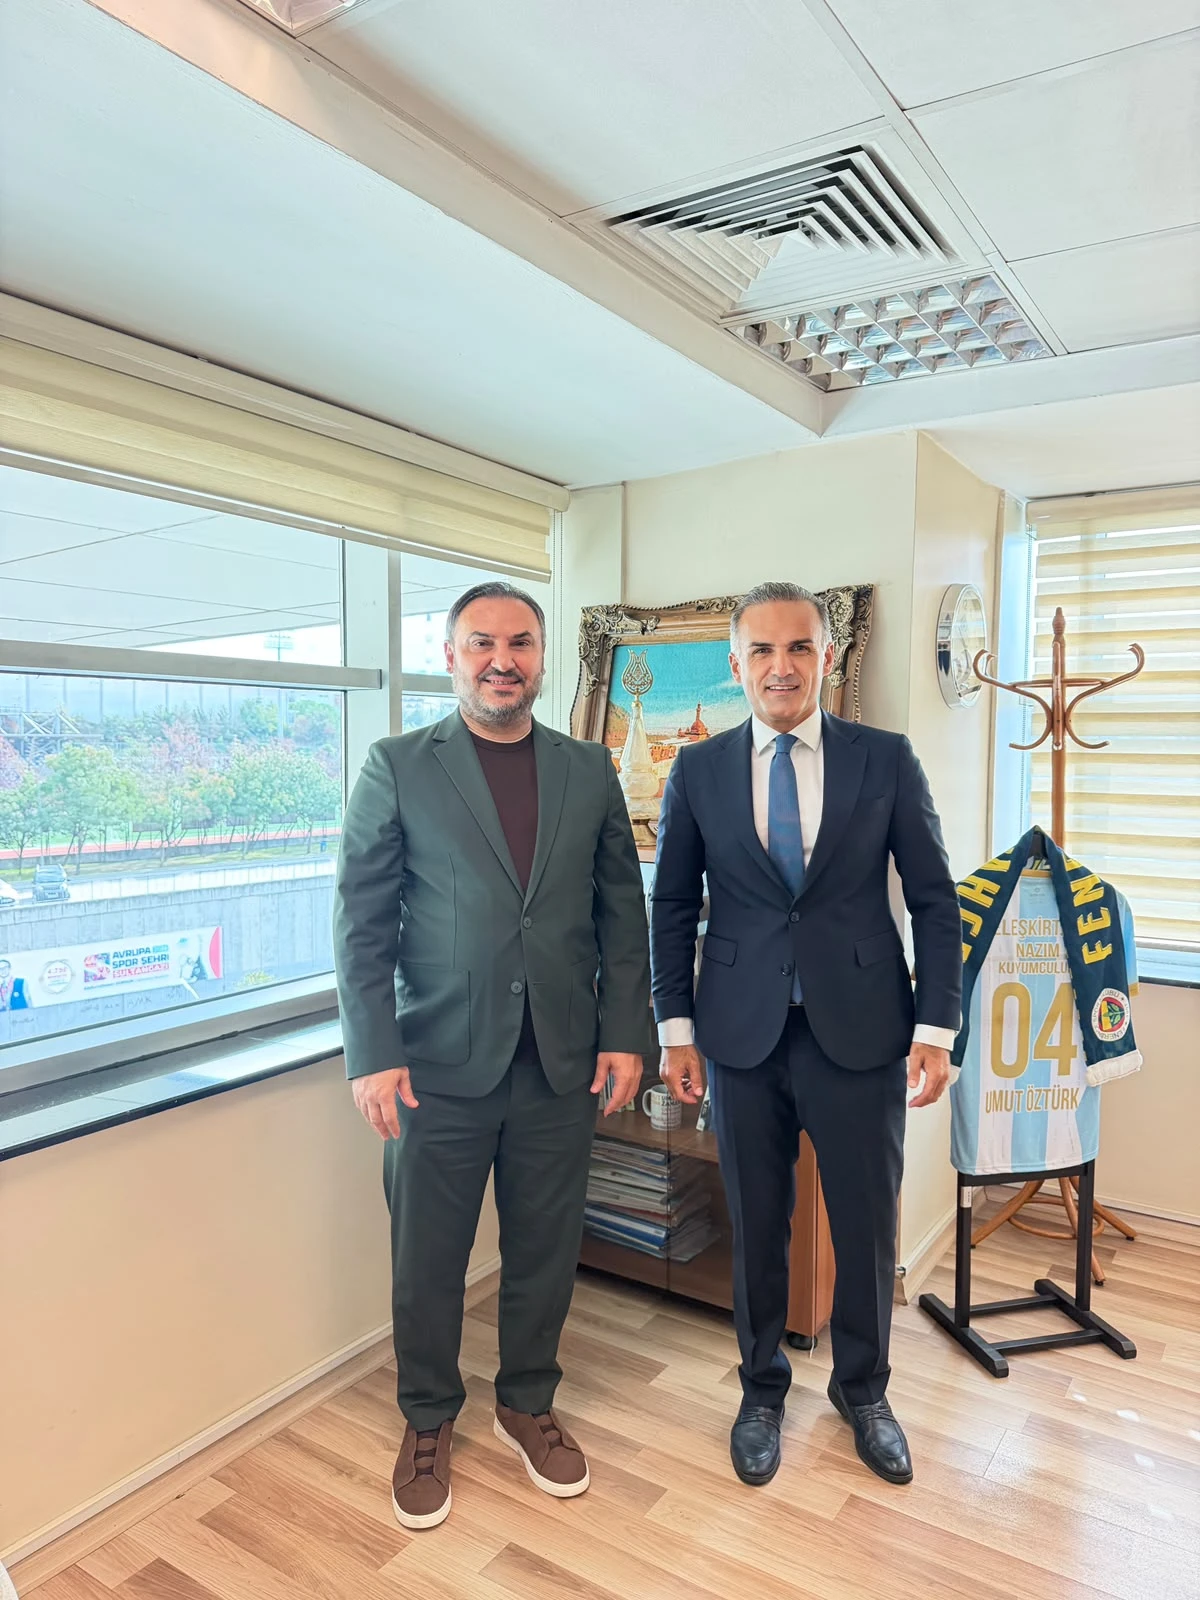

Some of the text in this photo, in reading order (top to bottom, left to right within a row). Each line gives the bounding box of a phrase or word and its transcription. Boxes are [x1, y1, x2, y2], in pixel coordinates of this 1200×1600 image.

[112, 946, 151, 959] AVRUPA
[1016, 943, 1060, 957] NAZIM
[112, 958, 139, 969] SPOR
[990, 981, 1078, 1078] 04
[985, 1084, 1080, 1114] UMUT ÖZTÜRK
